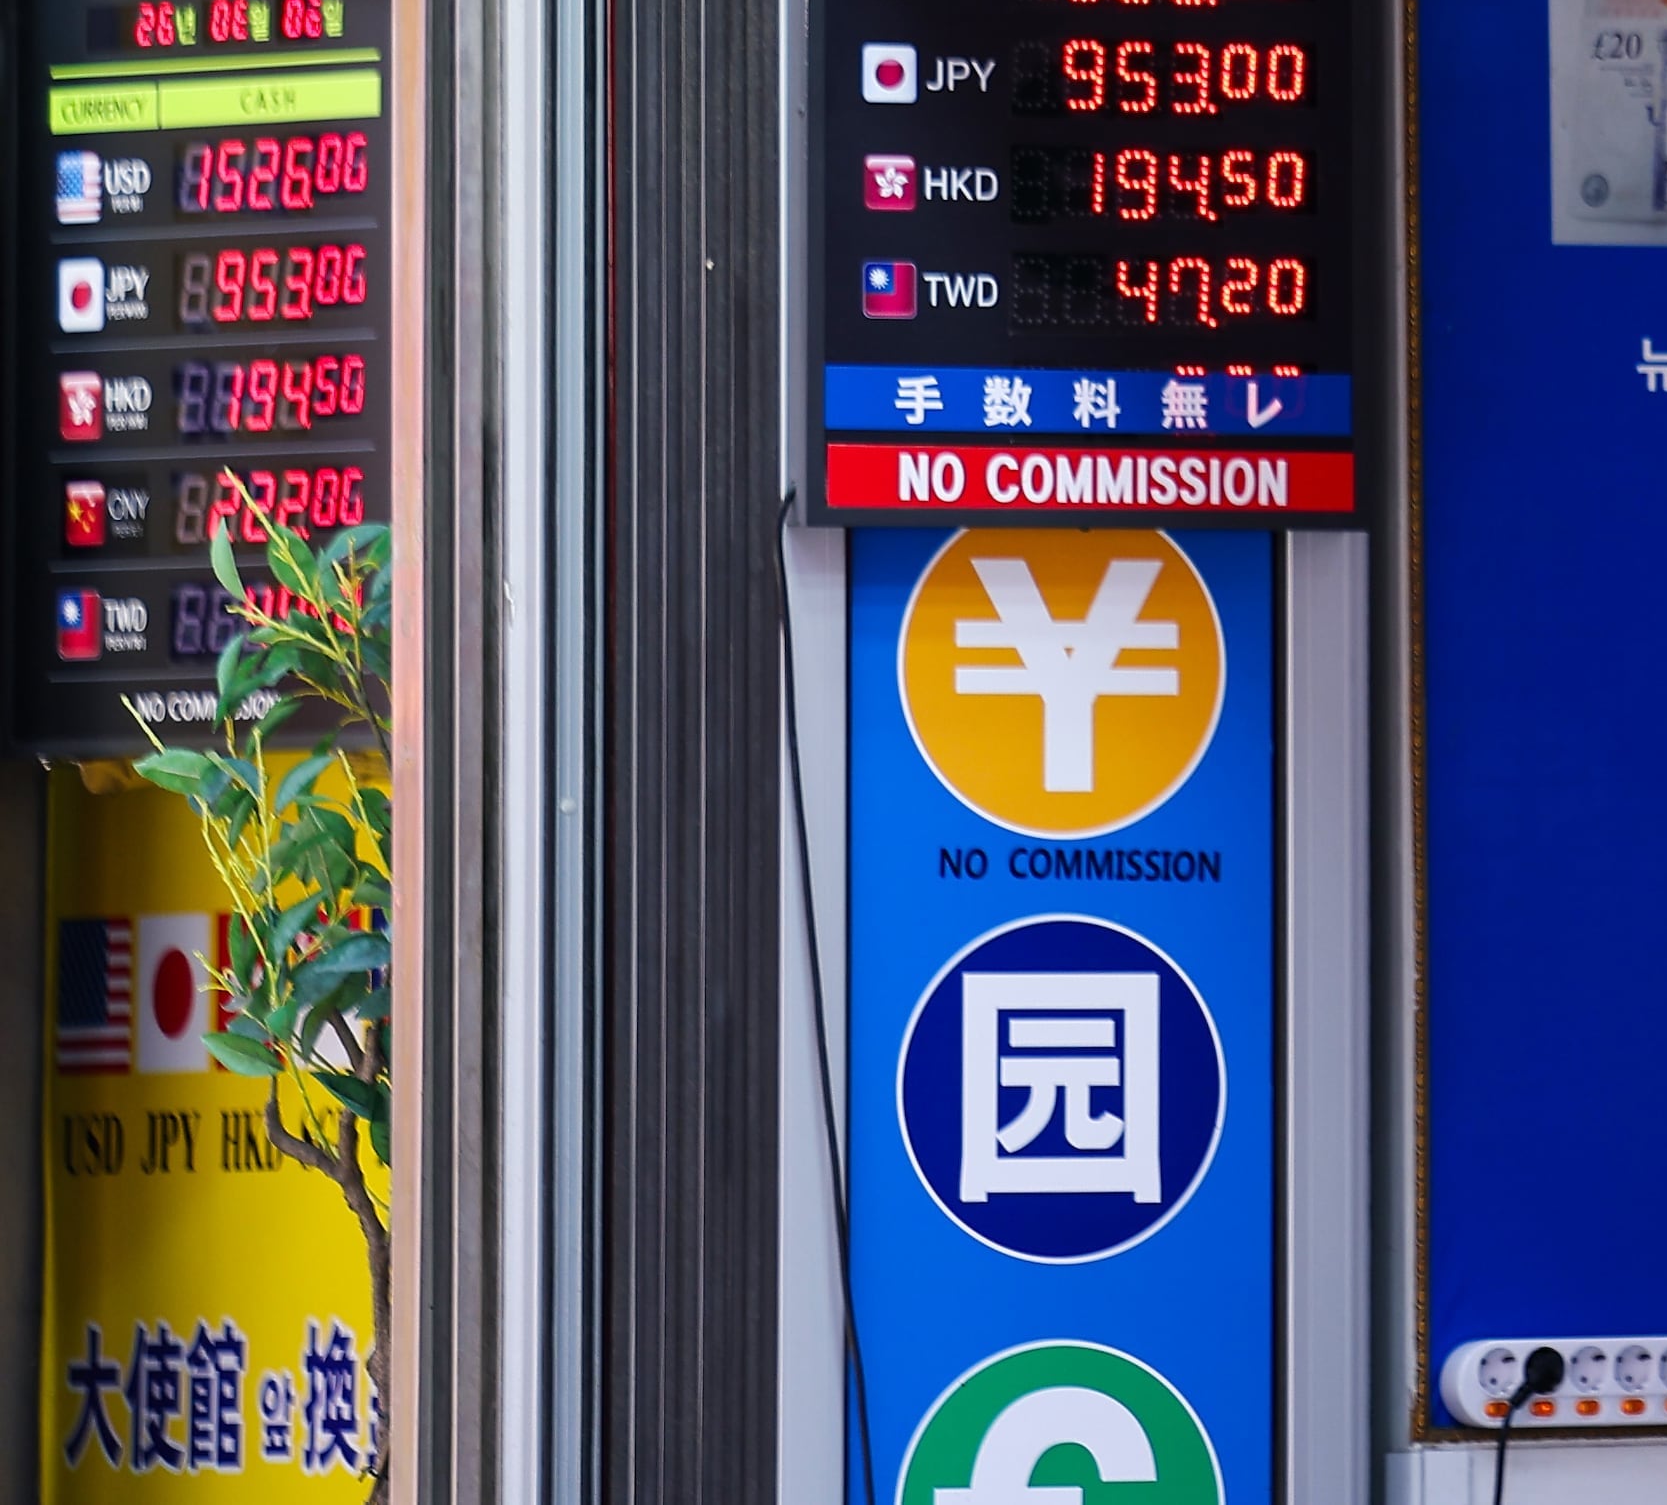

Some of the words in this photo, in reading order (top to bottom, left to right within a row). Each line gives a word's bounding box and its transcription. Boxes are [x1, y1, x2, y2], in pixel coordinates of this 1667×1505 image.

[925, 60, 997, 94] JPY
[61, 95, 146, 125] CURRENCY
[239, 87, 297, 115] CASH
[104, 157, 152, 196] USD
[924, 167, 998, 202] HKD
[106, 265, 150, 302] JPY
[923, 273, 998, 308] TWD
[104, 375, 153, 413] HKD
[899, 452, 965, 504] NO
[985, 456, 1289, 508] COMMISSION
[107, 487, 150, 521] CNY
[104, 597, 148, 634] TWD
[135, 692, 166, 723] NO
[939, 847, 988, 880] NO
[1009, 848, 1222, 884] COMMISSION
[63, 1112, 124, 1179] USD
[140, 1111, 201, 1177] JPY
[64, 1317, 246, 1475] 大使館
[260, 1369, 295, 1463] 앞
